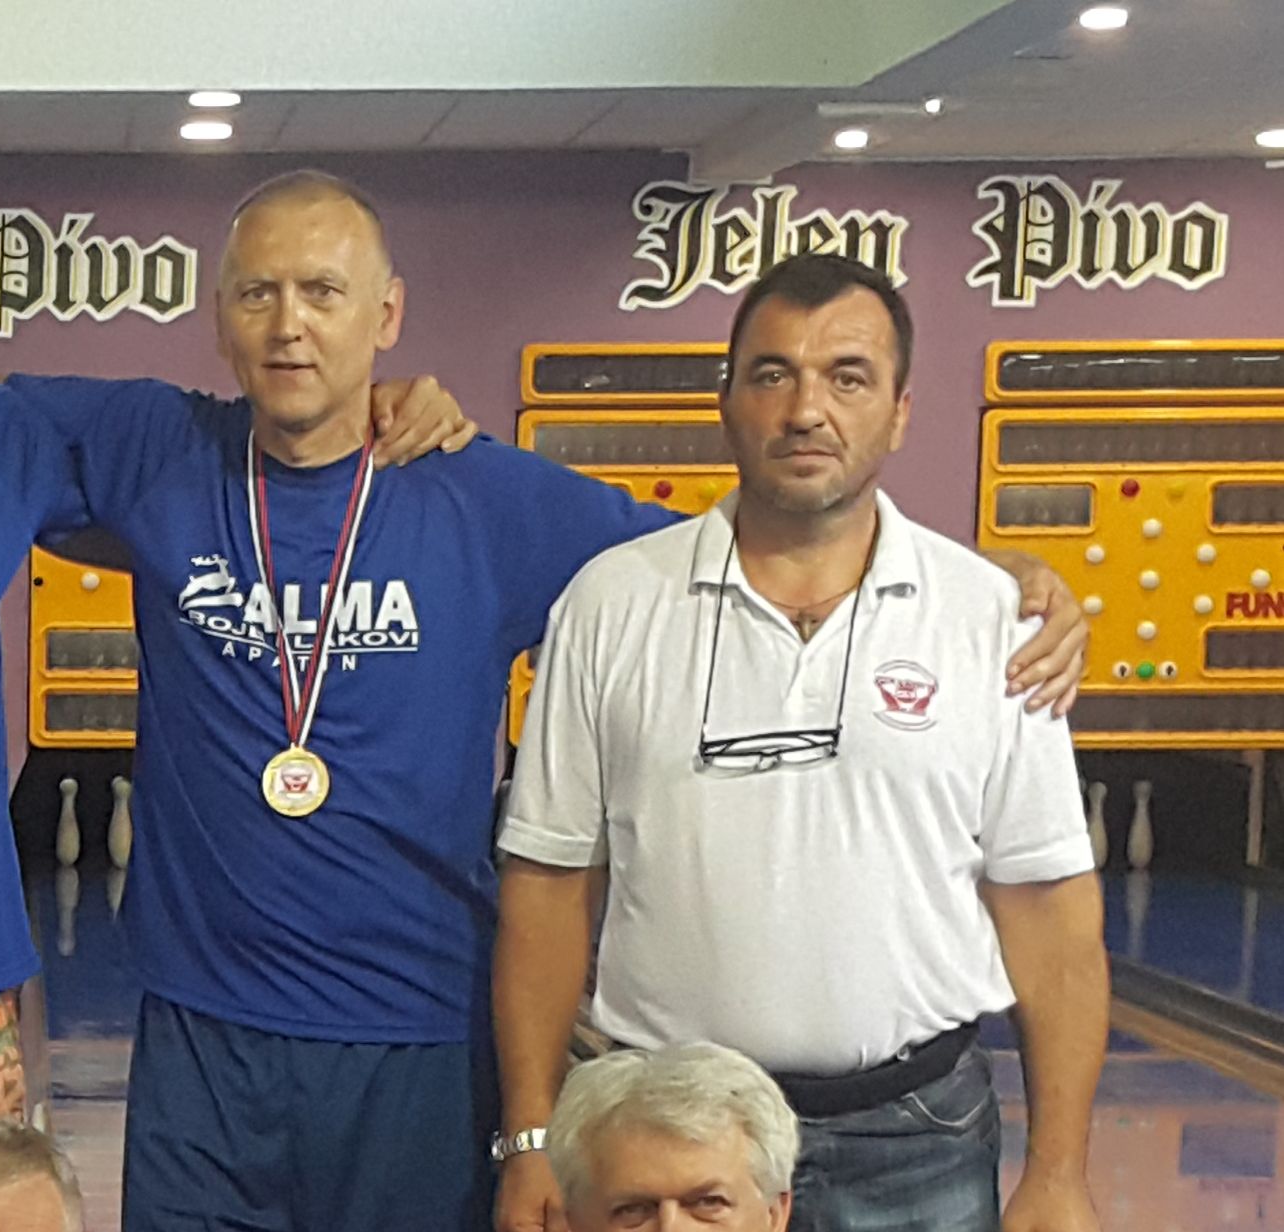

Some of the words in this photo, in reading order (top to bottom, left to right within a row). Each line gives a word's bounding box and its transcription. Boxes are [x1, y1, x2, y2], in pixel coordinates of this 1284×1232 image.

[965, 175, 1229, 308] Pivo
[243, 580, 418, 633] ALMA
[294, 631, 419, 649] LKOVI
